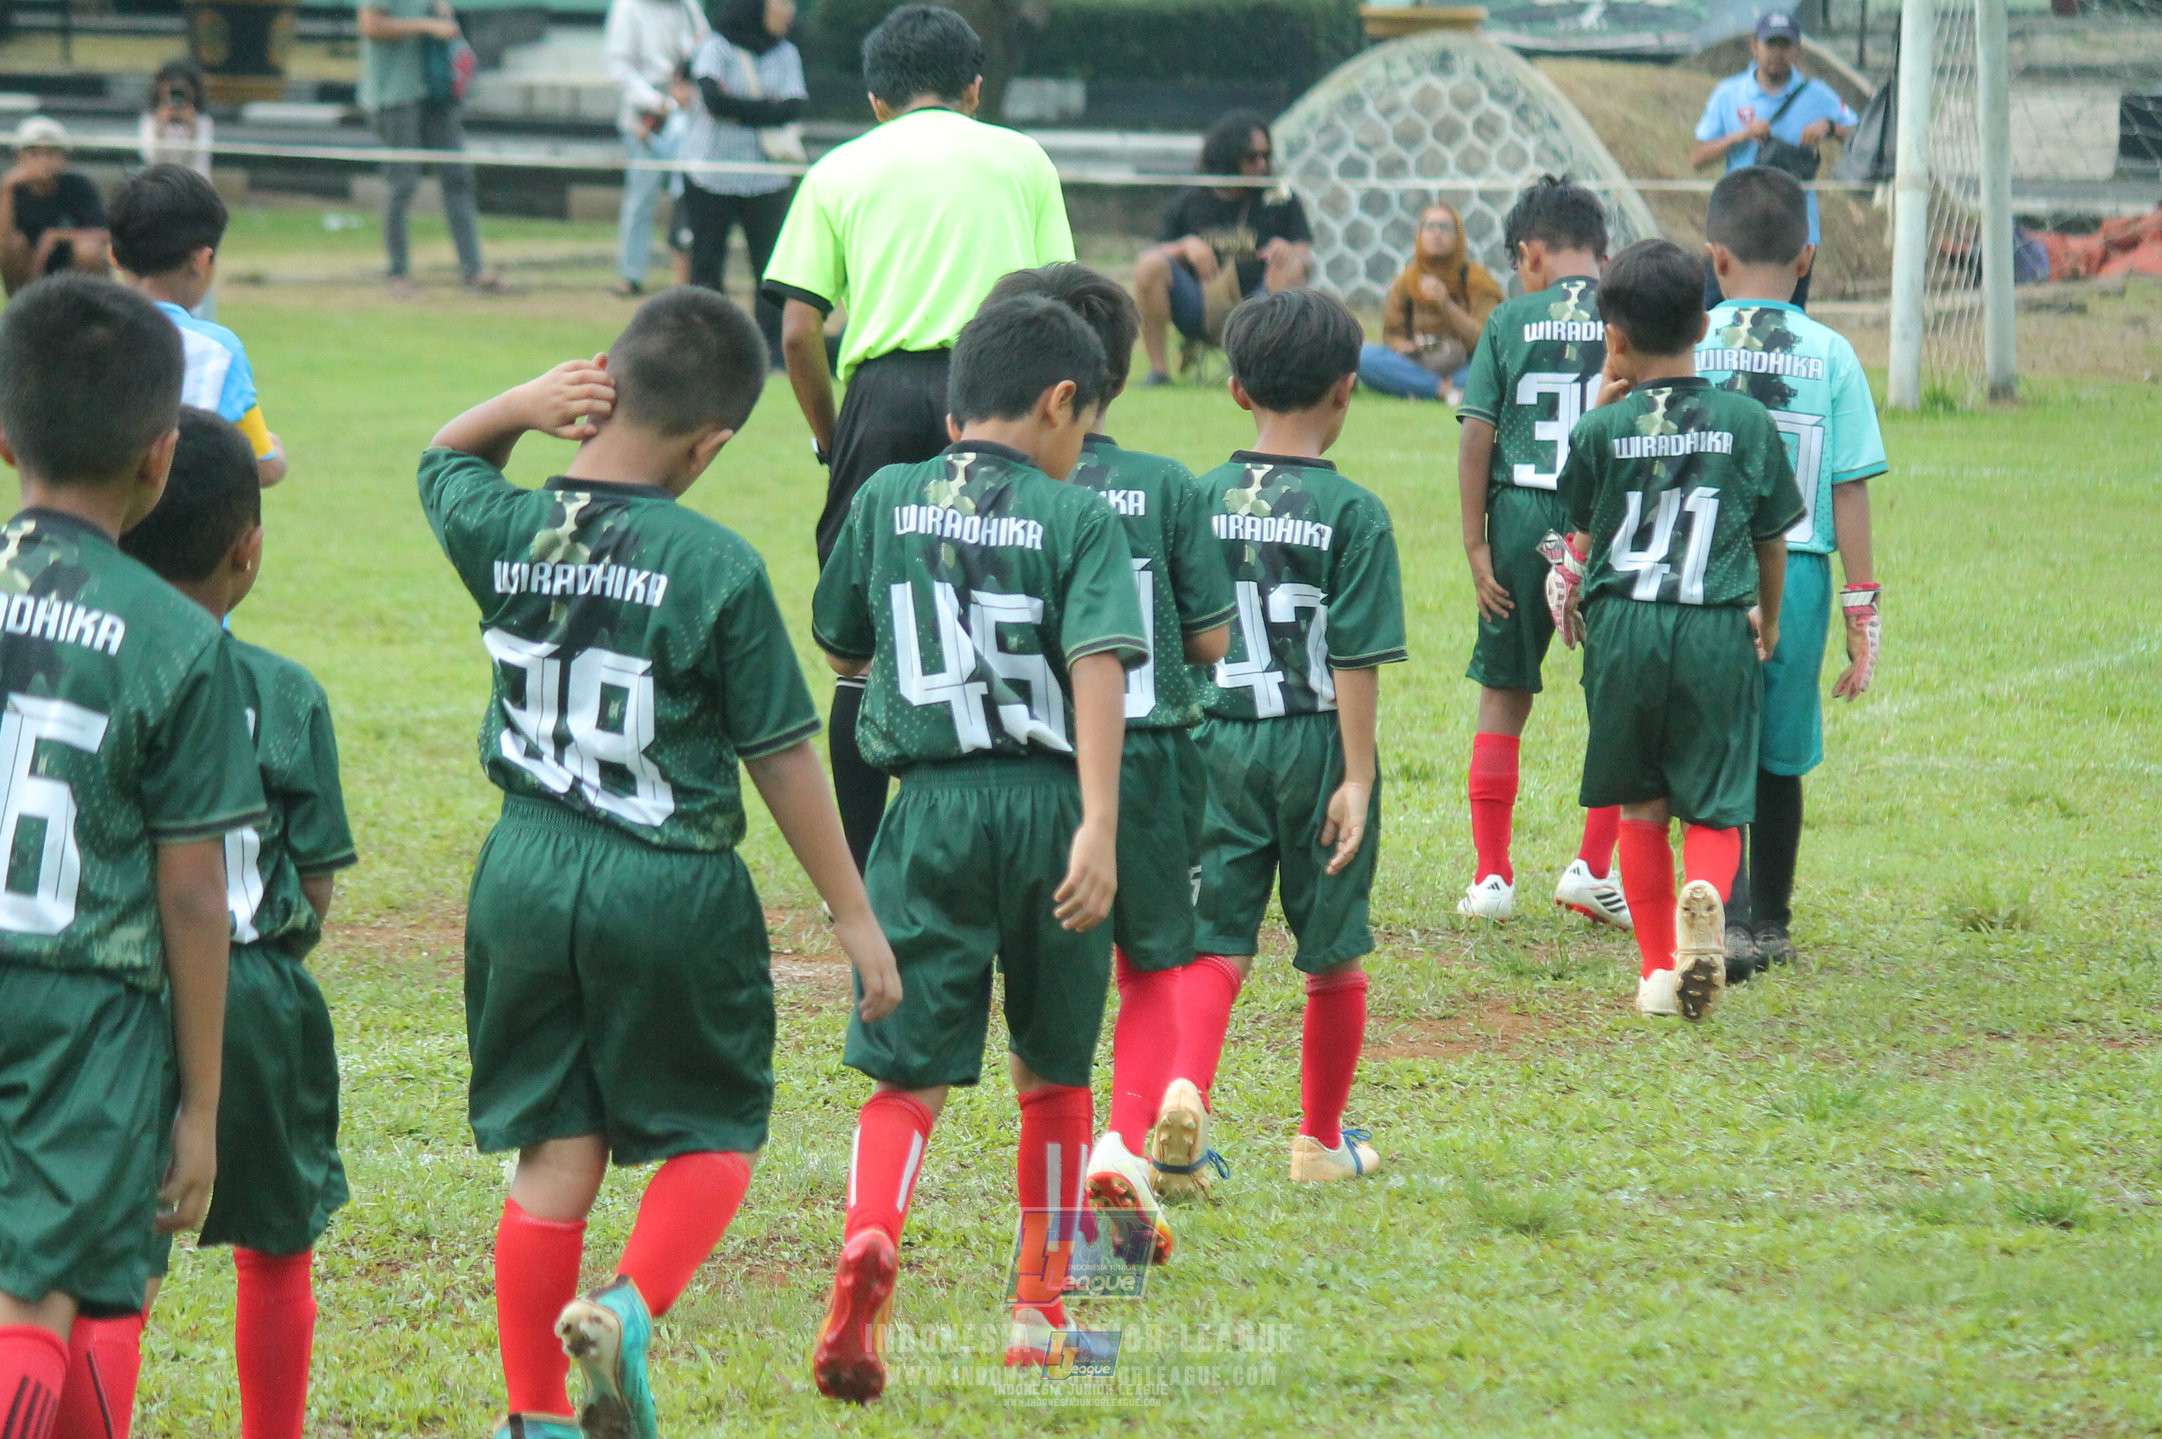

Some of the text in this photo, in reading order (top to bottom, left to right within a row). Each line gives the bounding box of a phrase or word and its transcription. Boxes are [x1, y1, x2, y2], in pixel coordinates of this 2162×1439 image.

[1695, 348, 1825, 380] WIRADHIKA
[1613, 431, 1734, 459] WIRADHIKA
[894, 504, 1044, 550] WIRADHIKA
[1608, 486, 1720, 605] 41
[493, 560, 668, 608] WIRADHIKA
[890, 579, 1074, 754] 45
[1216, 580, 1338, 719] 47
